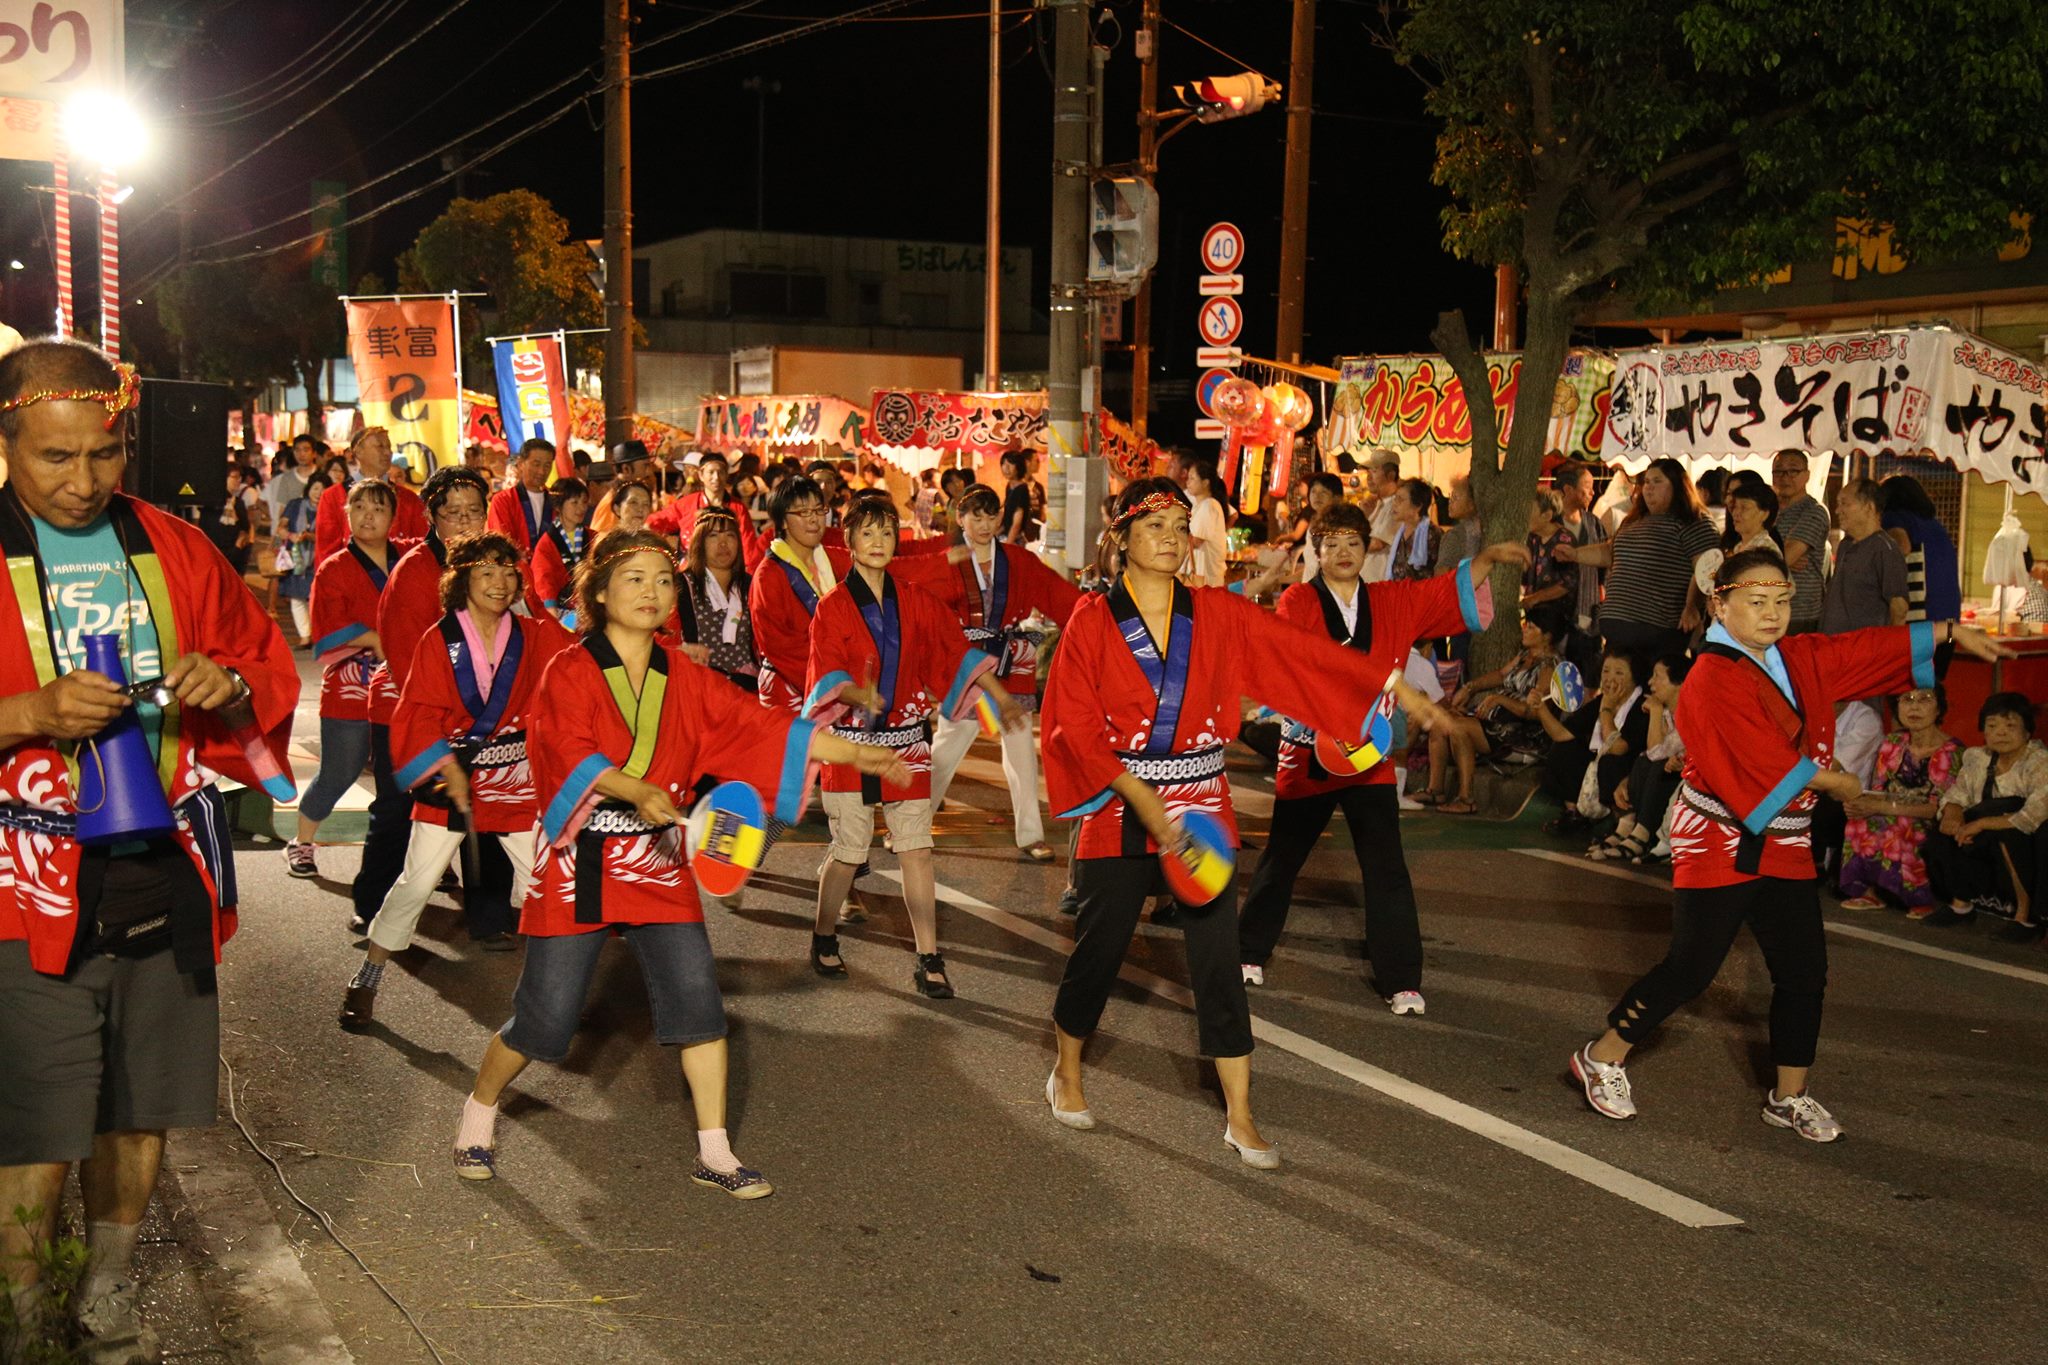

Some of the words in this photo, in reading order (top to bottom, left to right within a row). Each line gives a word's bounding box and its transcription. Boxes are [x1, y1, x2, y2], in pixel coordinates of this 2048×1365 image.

[1211, 238, 1234, 260] 40
[1954, 341, 2048, 398] 元祖鉄板
[1665, 364, 1910, 449] やきそば
[53, 560, 111, 575] MARATHON
